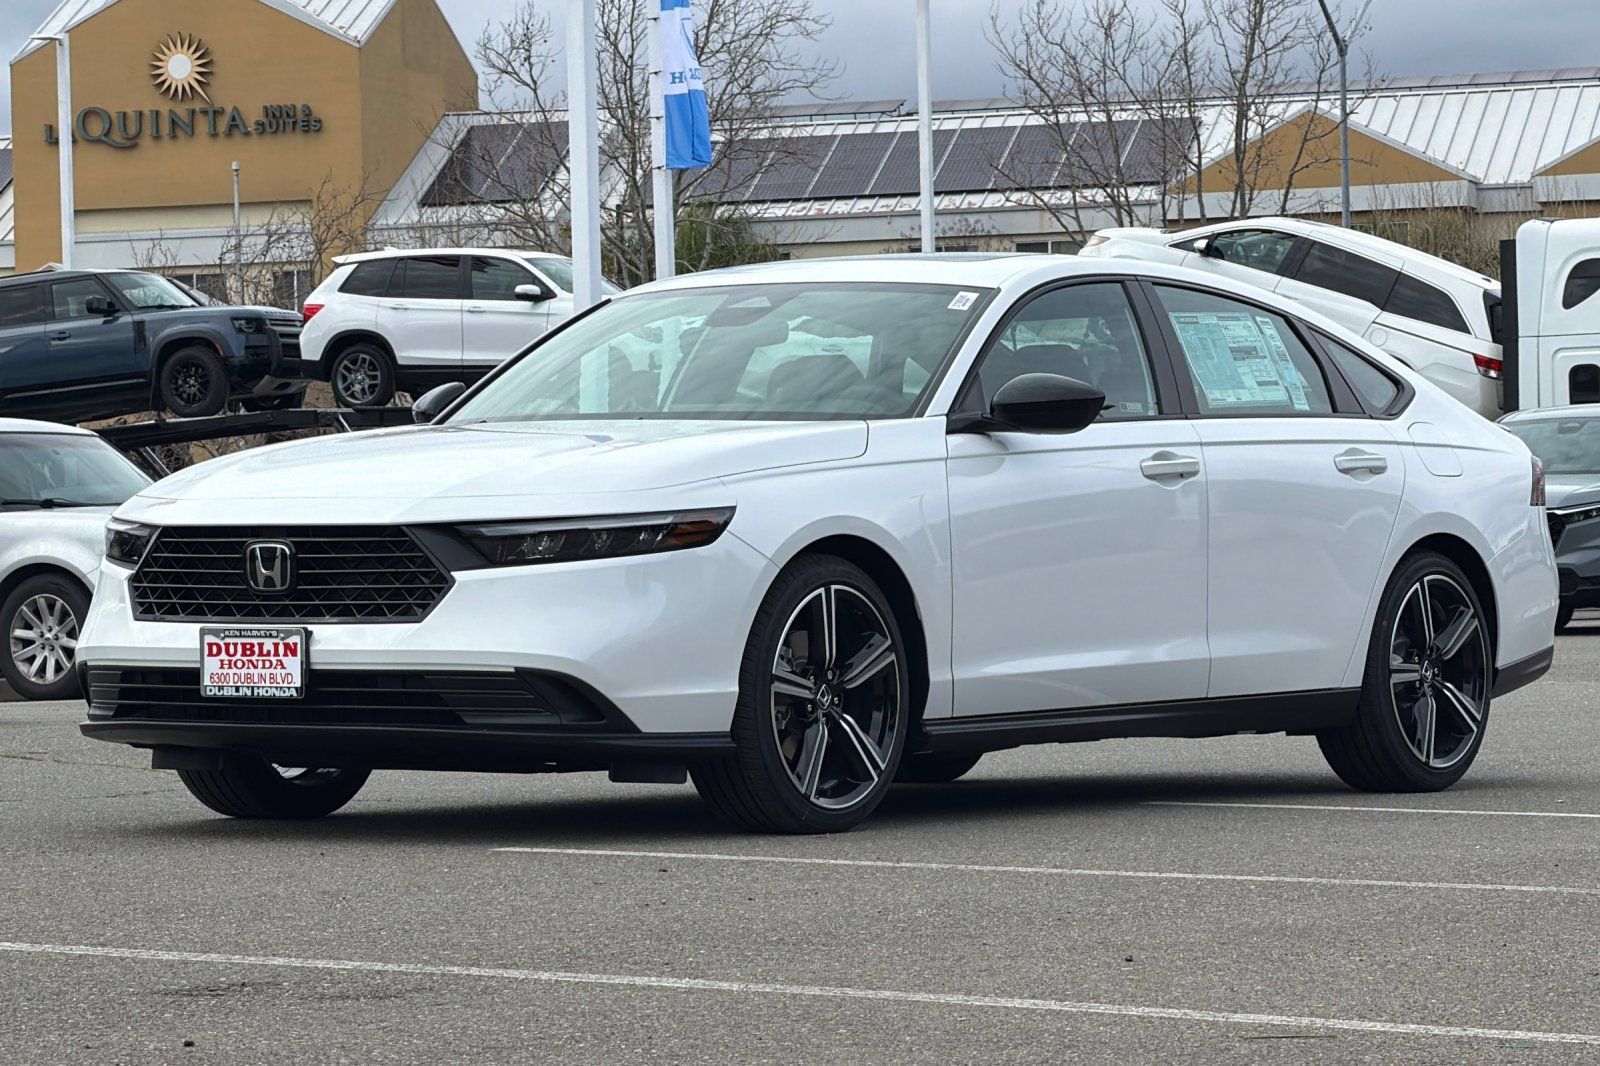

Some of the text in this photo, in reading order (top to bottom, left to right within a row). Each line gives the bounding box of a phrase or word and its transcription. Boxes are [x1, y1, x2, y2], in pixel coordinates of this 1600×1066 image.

[262, 104, 297, 119] INN
[44, 105, 250, 148] L QUINTA
[254, 117, 323, 135] SUITES
[206, 641, 298, 657] DUBLIN
[218, 658, 287, 670] HONDA
[209, 672, 296, 685] 6300 DUBLIN BLVD.
[206, 685, 298, 697] DUBLIN HONDA
